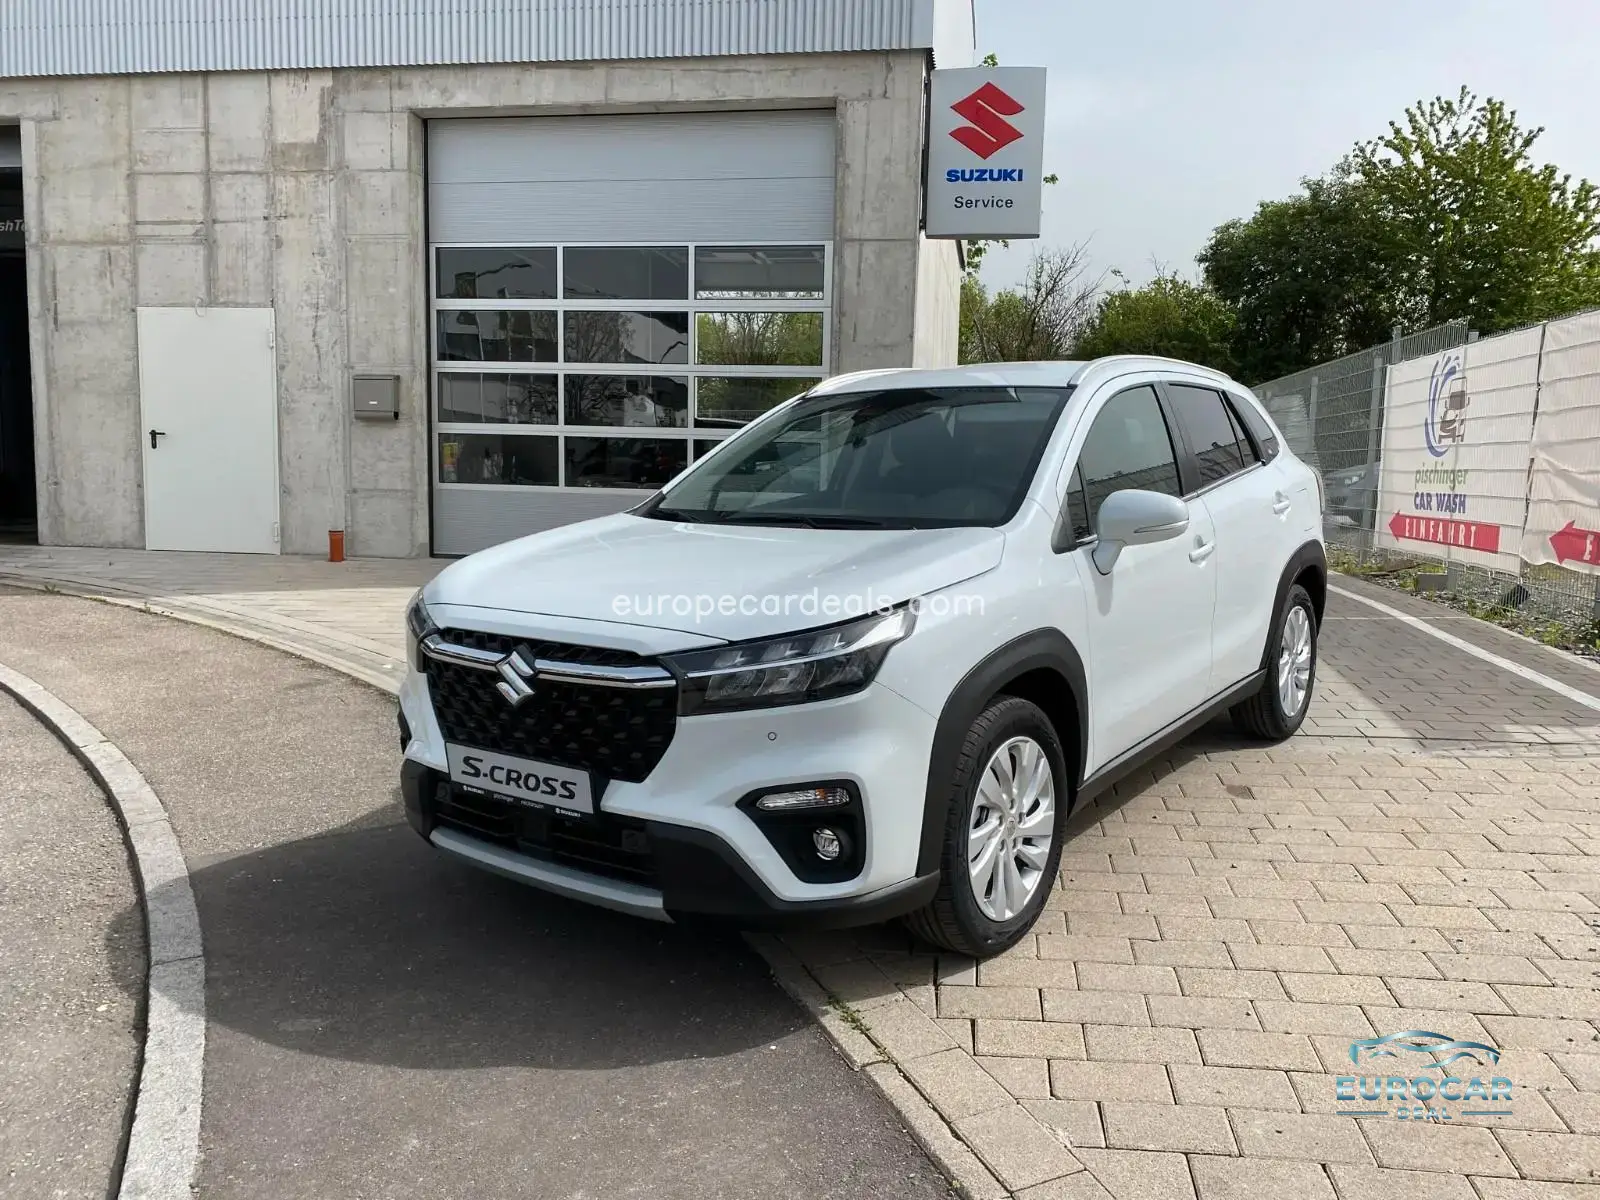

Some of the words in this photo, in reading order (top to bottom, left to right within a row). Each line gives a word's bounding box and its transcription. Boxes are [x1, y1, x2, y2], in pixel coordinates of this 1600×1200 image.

[946, 169, 1023, 182] SUZUKI
[954, 196, 1014, 209] Service
[1414, 461, 1469, 491] pischinger
[1414, 491, 1433, 511] CAR
[1435, 493, 1467, 513] WASH
[1405, 518, 1477, 547] EINFAHRT
